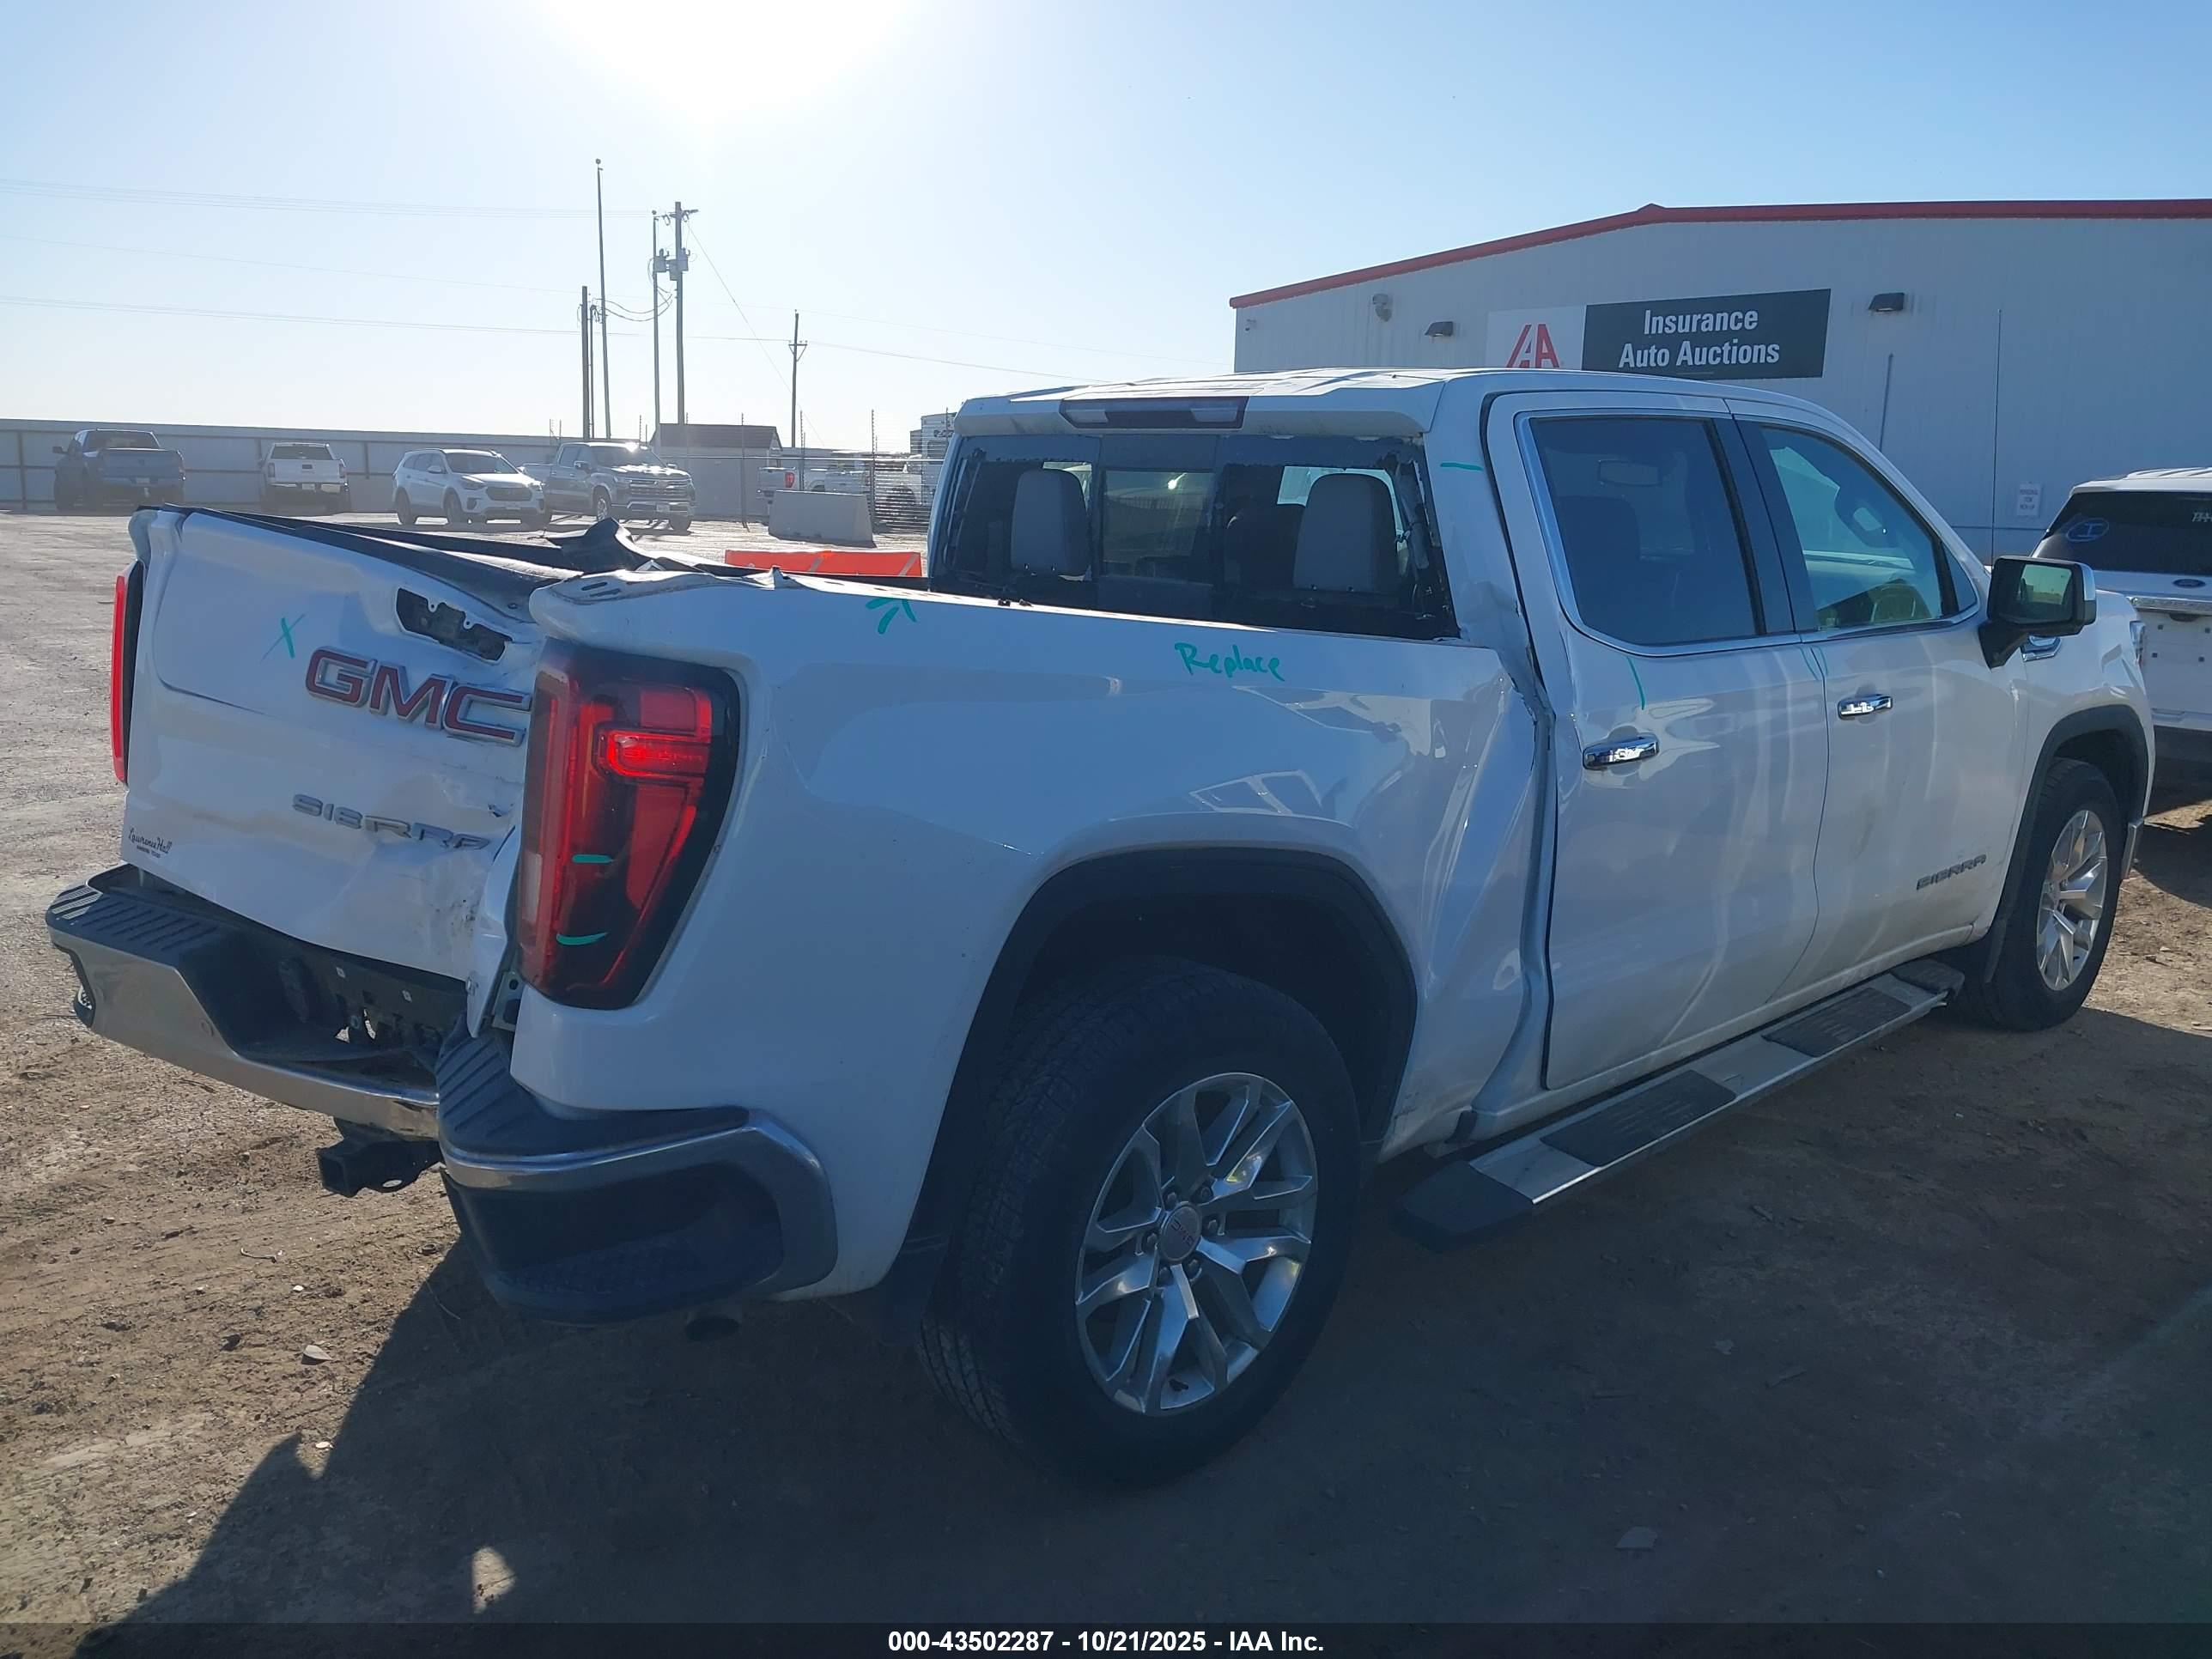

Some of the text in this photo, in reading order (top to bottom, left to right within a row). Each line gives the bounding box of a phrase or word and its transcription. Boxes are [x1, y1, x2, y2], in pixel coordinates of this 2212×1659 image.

[1644, 309, 1759, 335] Insurance
[1619, 338, 1780, 368] Auto Auctions
[1175, 642, 1285, 681] Replace
[306, 646, 532, 747] GMC
[291, 793, 490, 850] SIERRA
